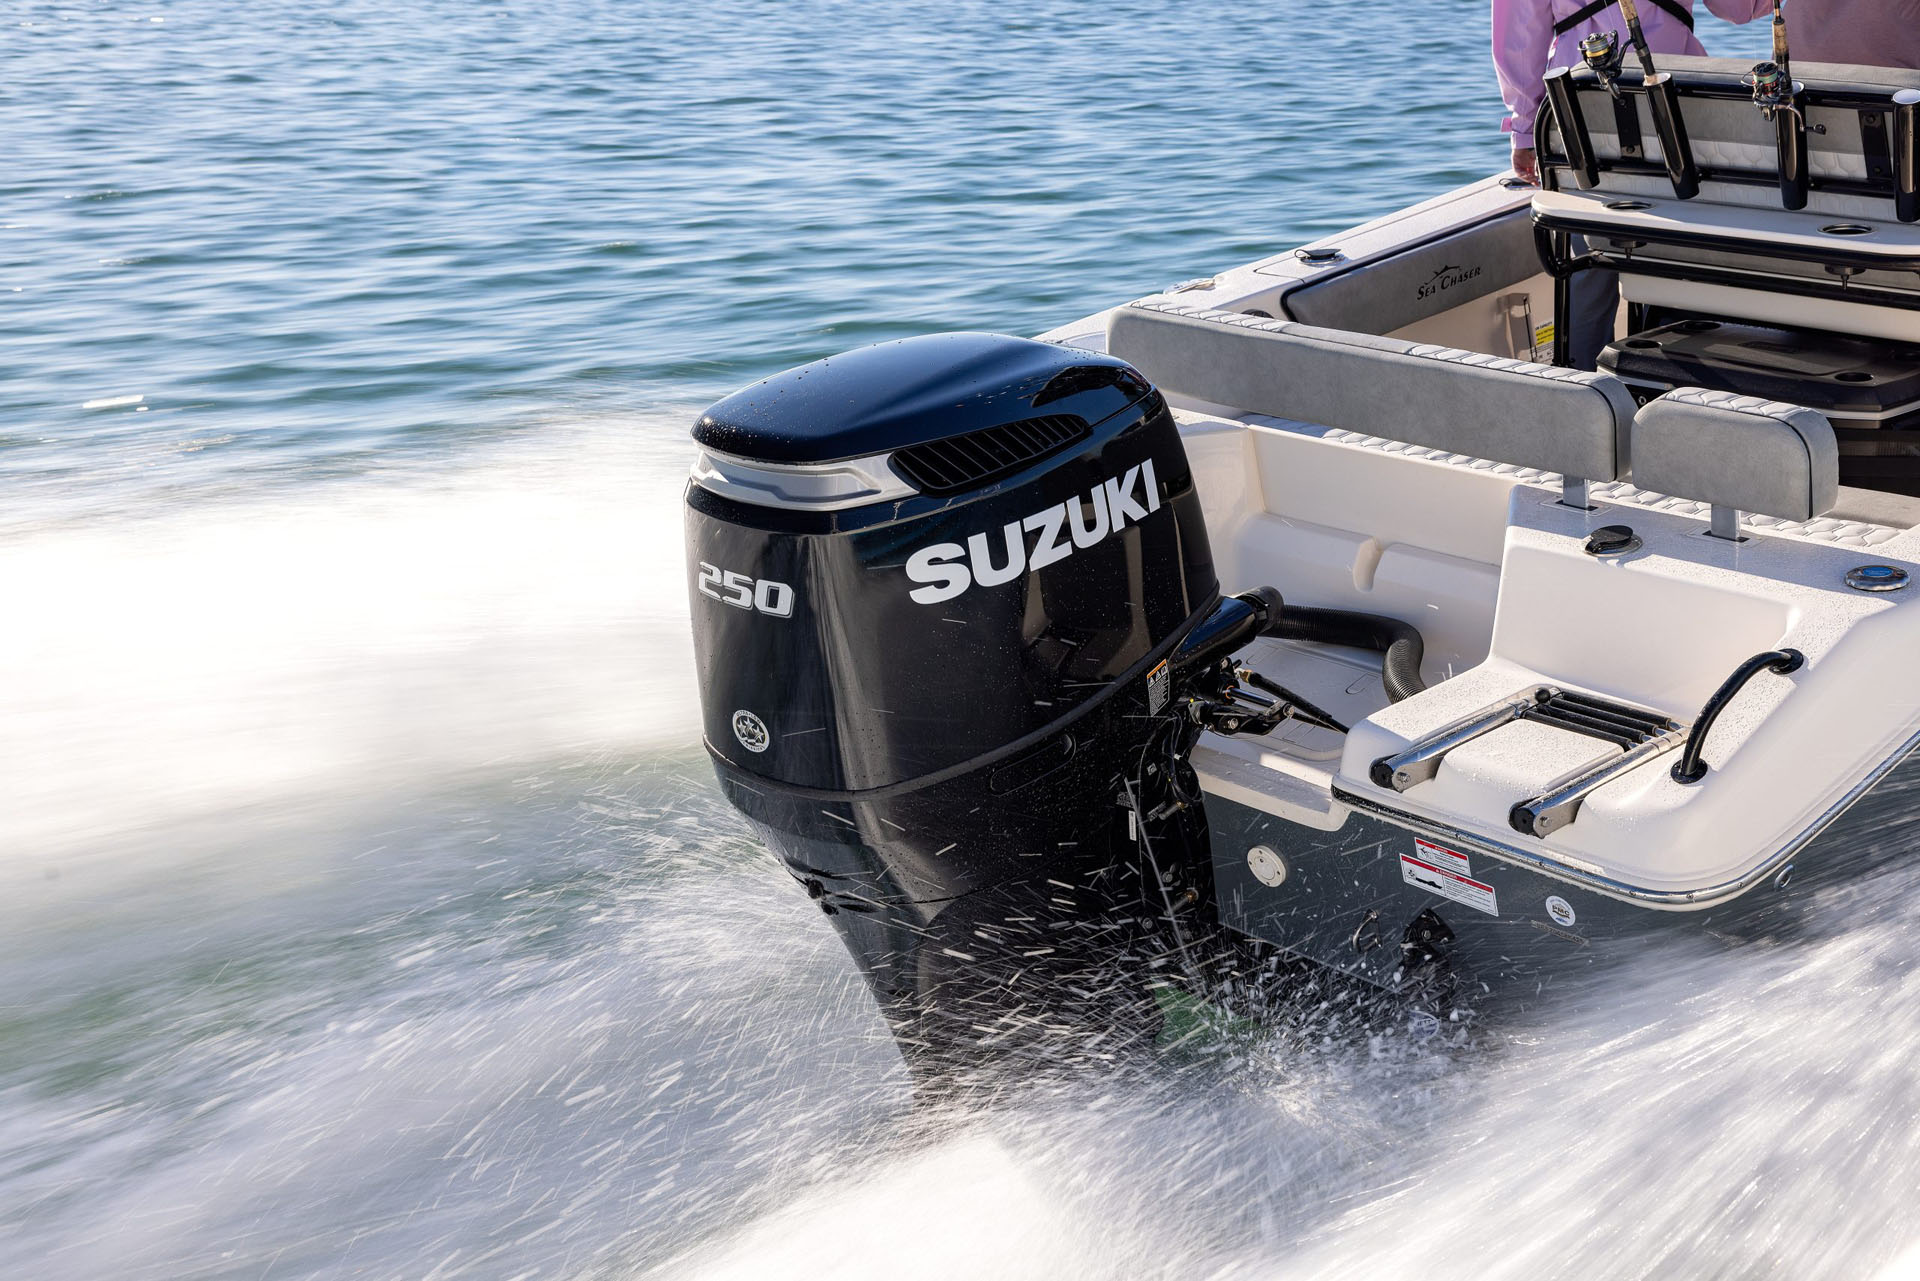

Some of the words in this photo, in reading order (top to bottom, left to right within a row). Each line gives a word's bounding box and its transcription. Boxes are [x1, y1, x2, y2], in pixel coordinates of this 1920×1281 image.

[1417, 285, 1436, 300] SEA
[1441, 266, 1480, 290] CHASER
[905, 457, 1160, 605] SUZUKI
[698, 561, 795, 618] 250
